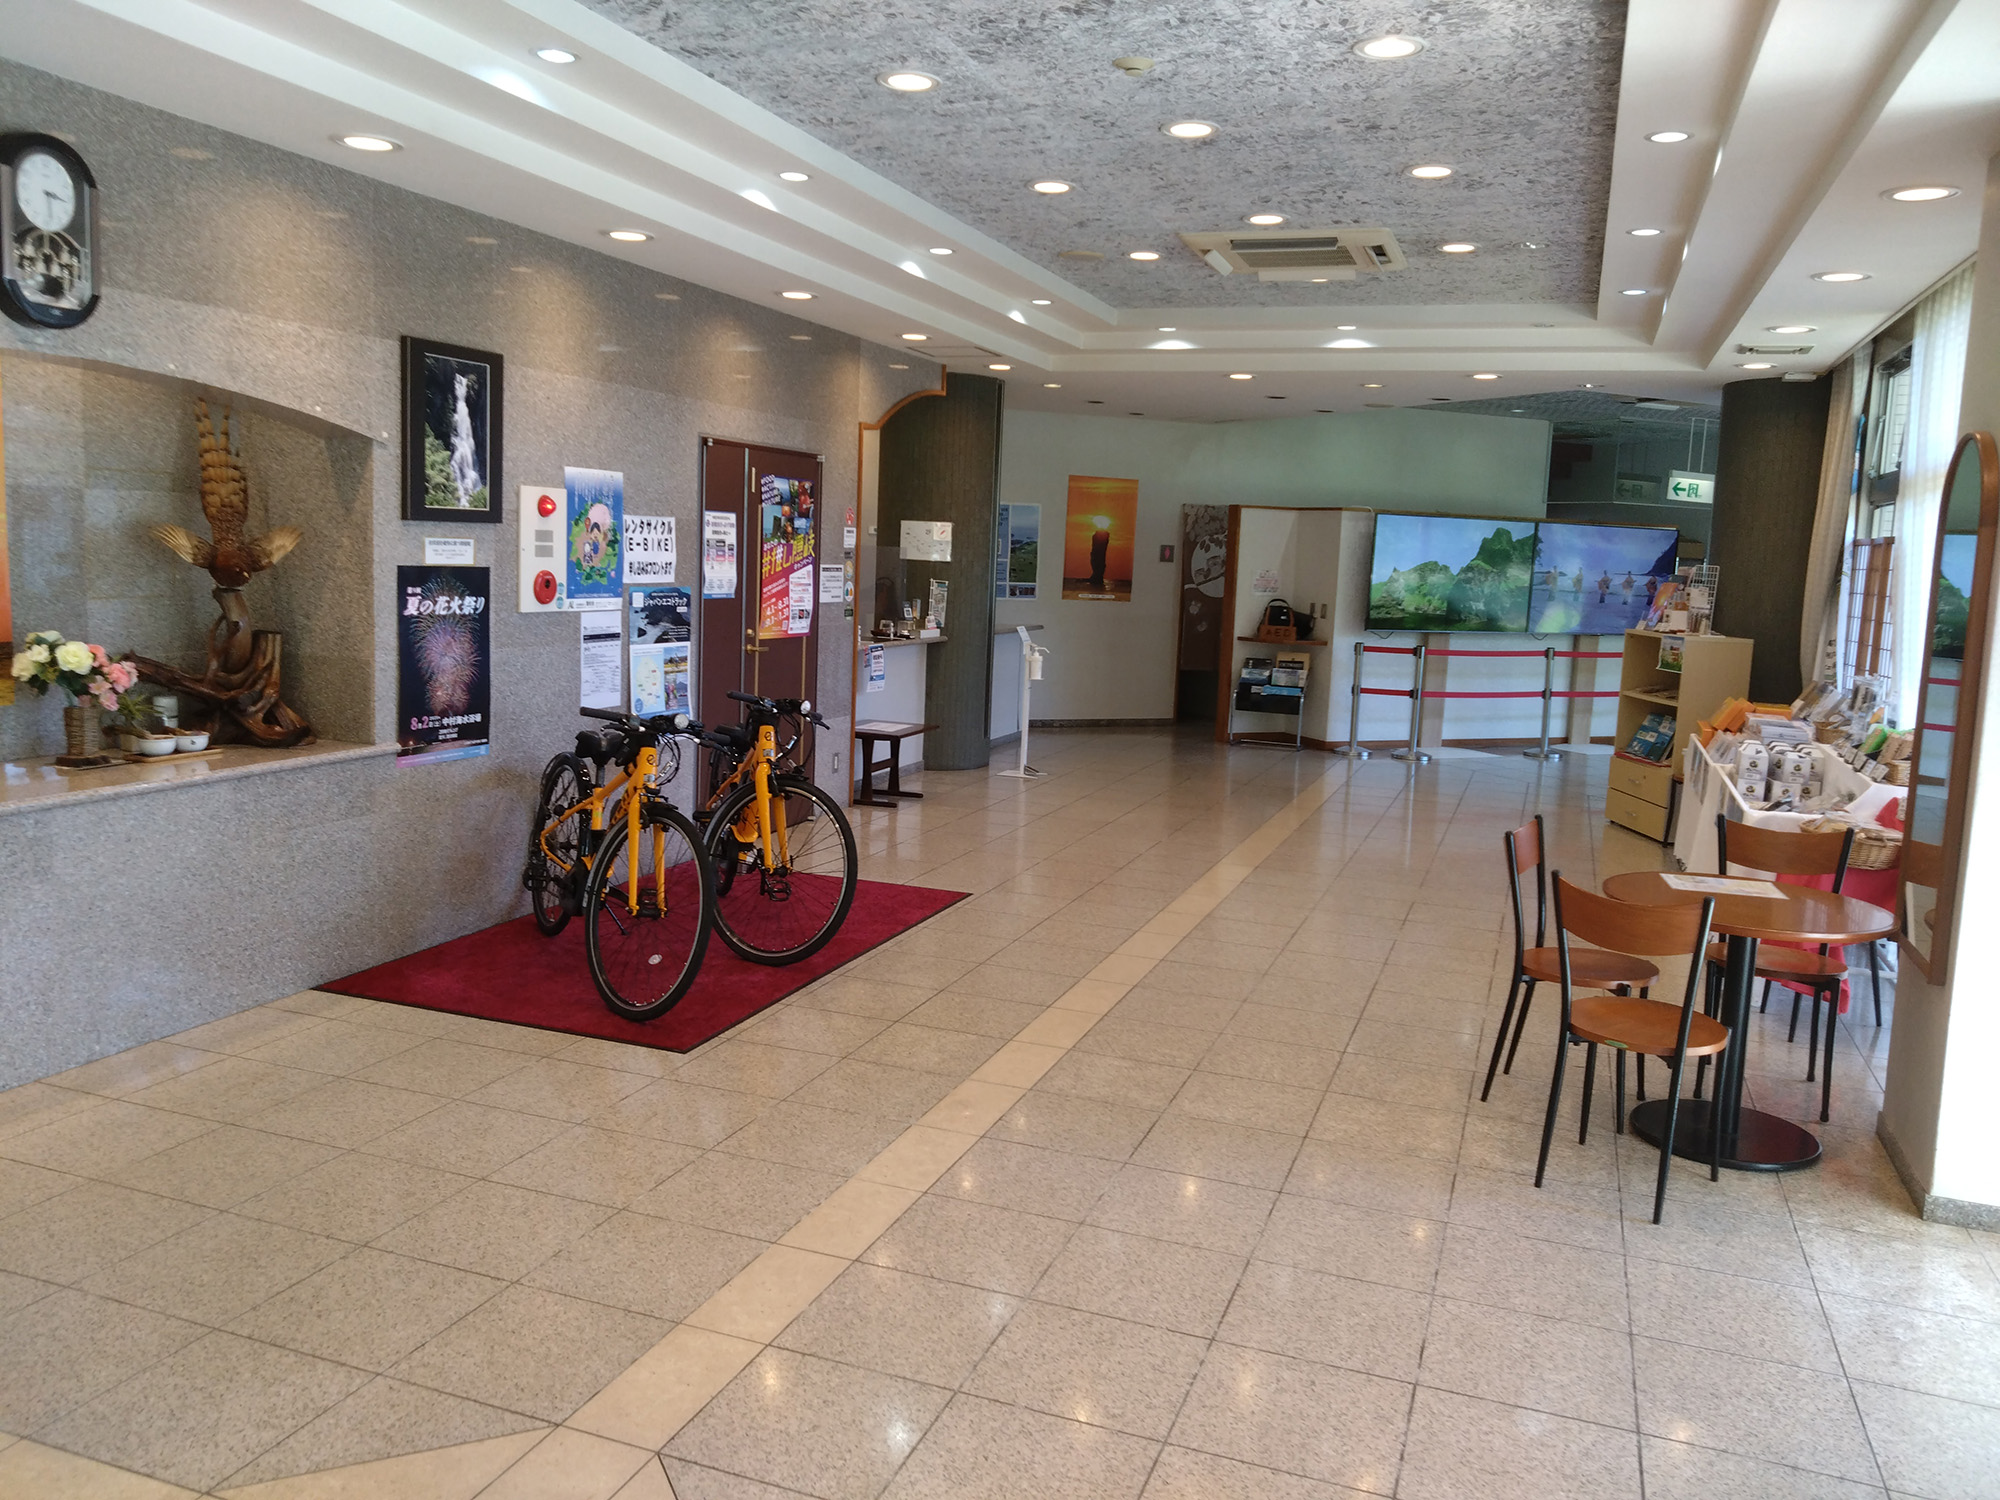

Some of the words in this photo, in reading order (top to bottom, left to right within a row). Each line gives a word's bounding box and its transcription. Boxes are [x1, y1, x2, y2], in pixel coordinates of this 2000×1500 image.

[625, 519, 672, 535] レンタサイクル
[625, 535, 673, 553] (E-BIKE)
[403, 595, 485, 616] 夏の花火祭り
[644, 597, 688, 606] ジャパンエコトラック
[1266, 629, 1290, 637] AED
